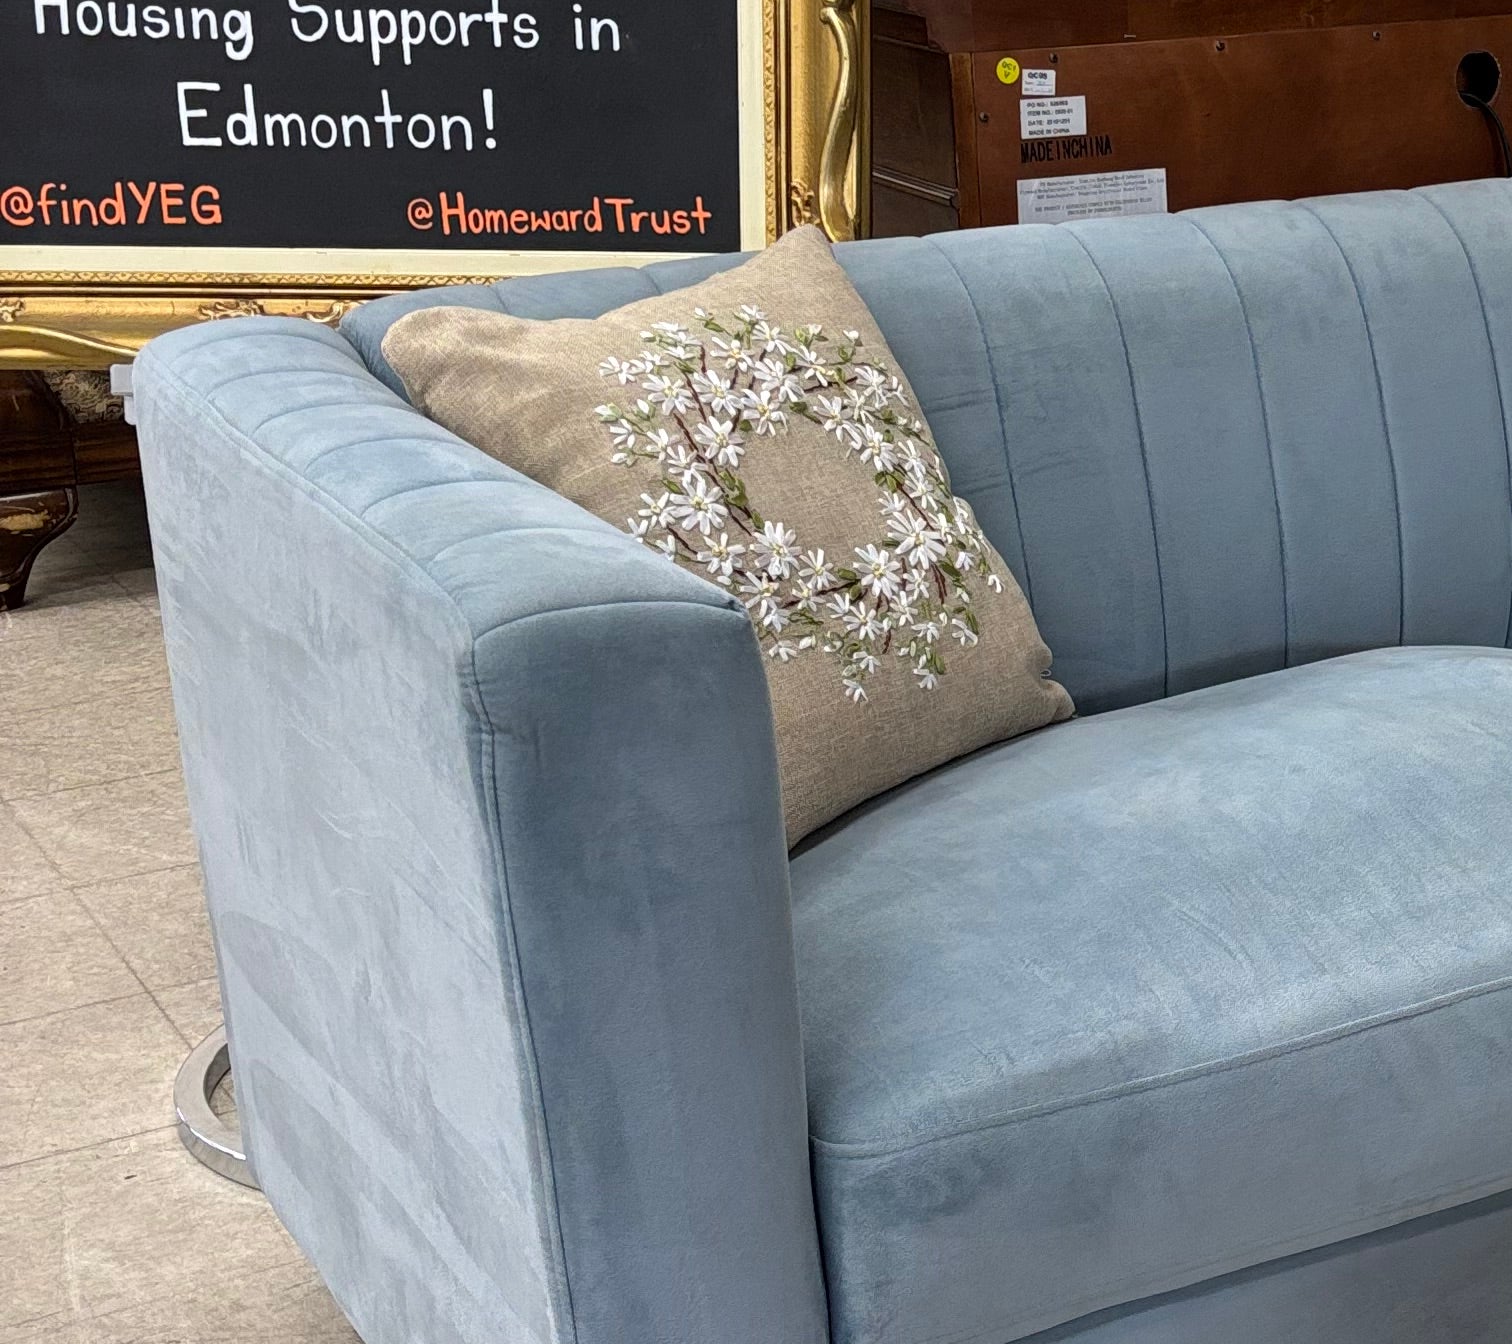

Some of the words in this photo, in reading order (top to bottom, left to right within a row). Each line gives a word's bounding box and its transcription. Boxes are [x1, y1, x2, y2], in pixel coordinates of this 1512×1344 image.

[573, 4, 621, 52] in
[177, 82, 497, 150] Edmonton!
[0, 182, 223, 227] @findYEG
[407, 192, 712, 235] @HomewardTrust
